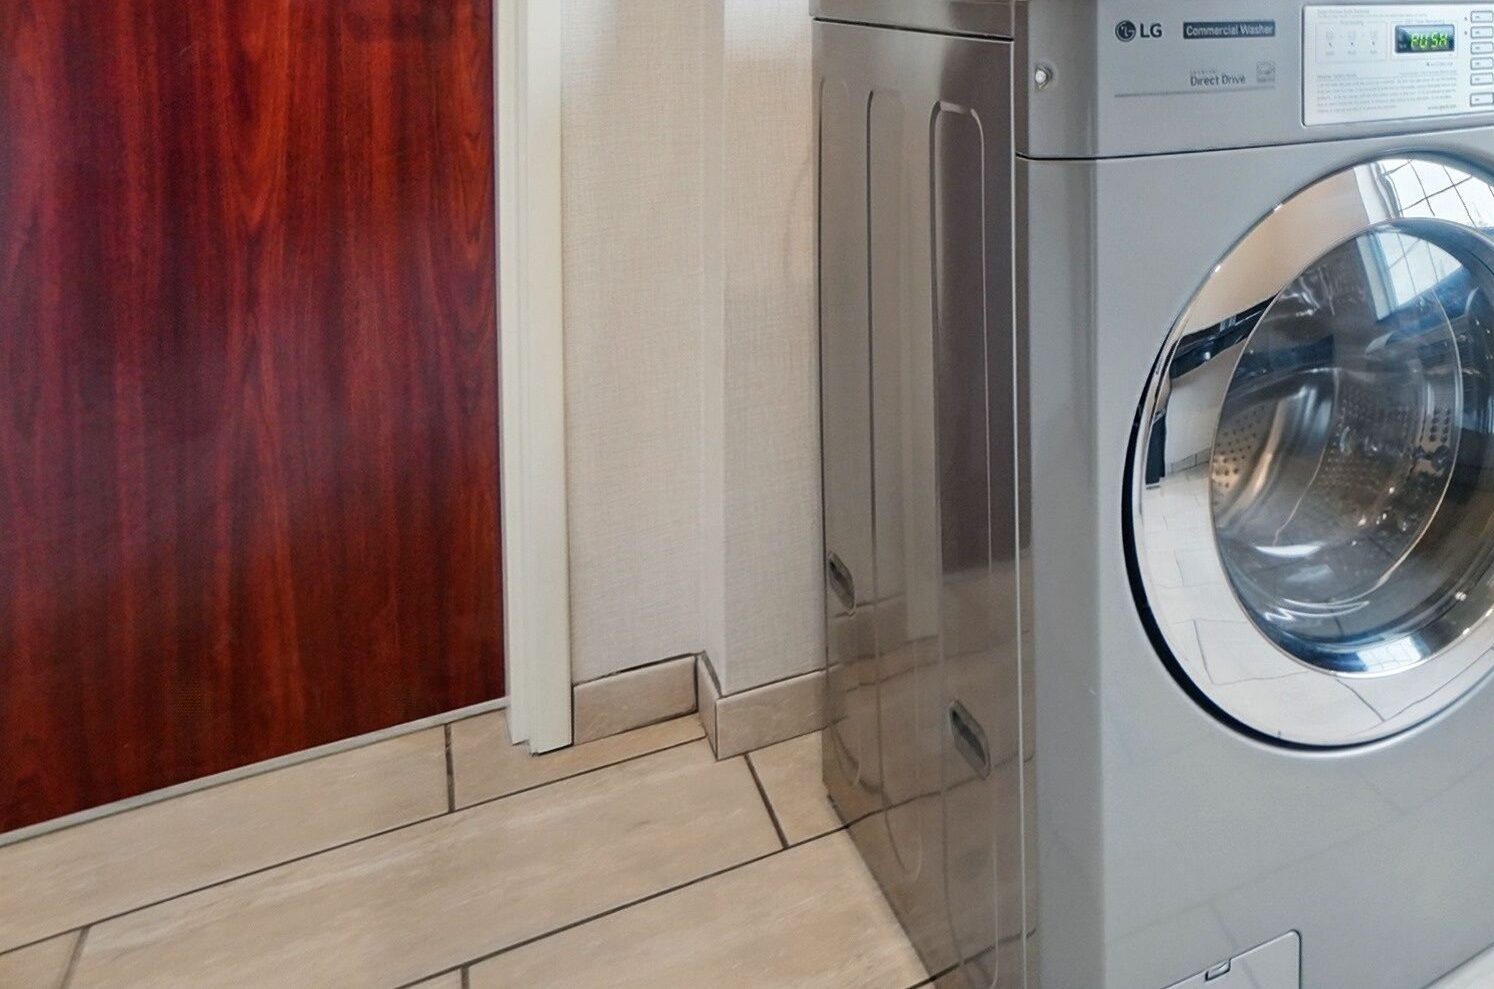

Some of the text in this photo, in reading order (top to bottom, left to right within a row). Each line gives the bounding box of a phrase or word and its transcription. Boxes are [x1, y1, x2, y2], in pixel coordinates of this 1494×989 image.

[1139, 23, 1163, 38] LG
[1186, 23, 1274, 36] Commercial Washer
[1190, 73, 1247, 86] Direct Drive
